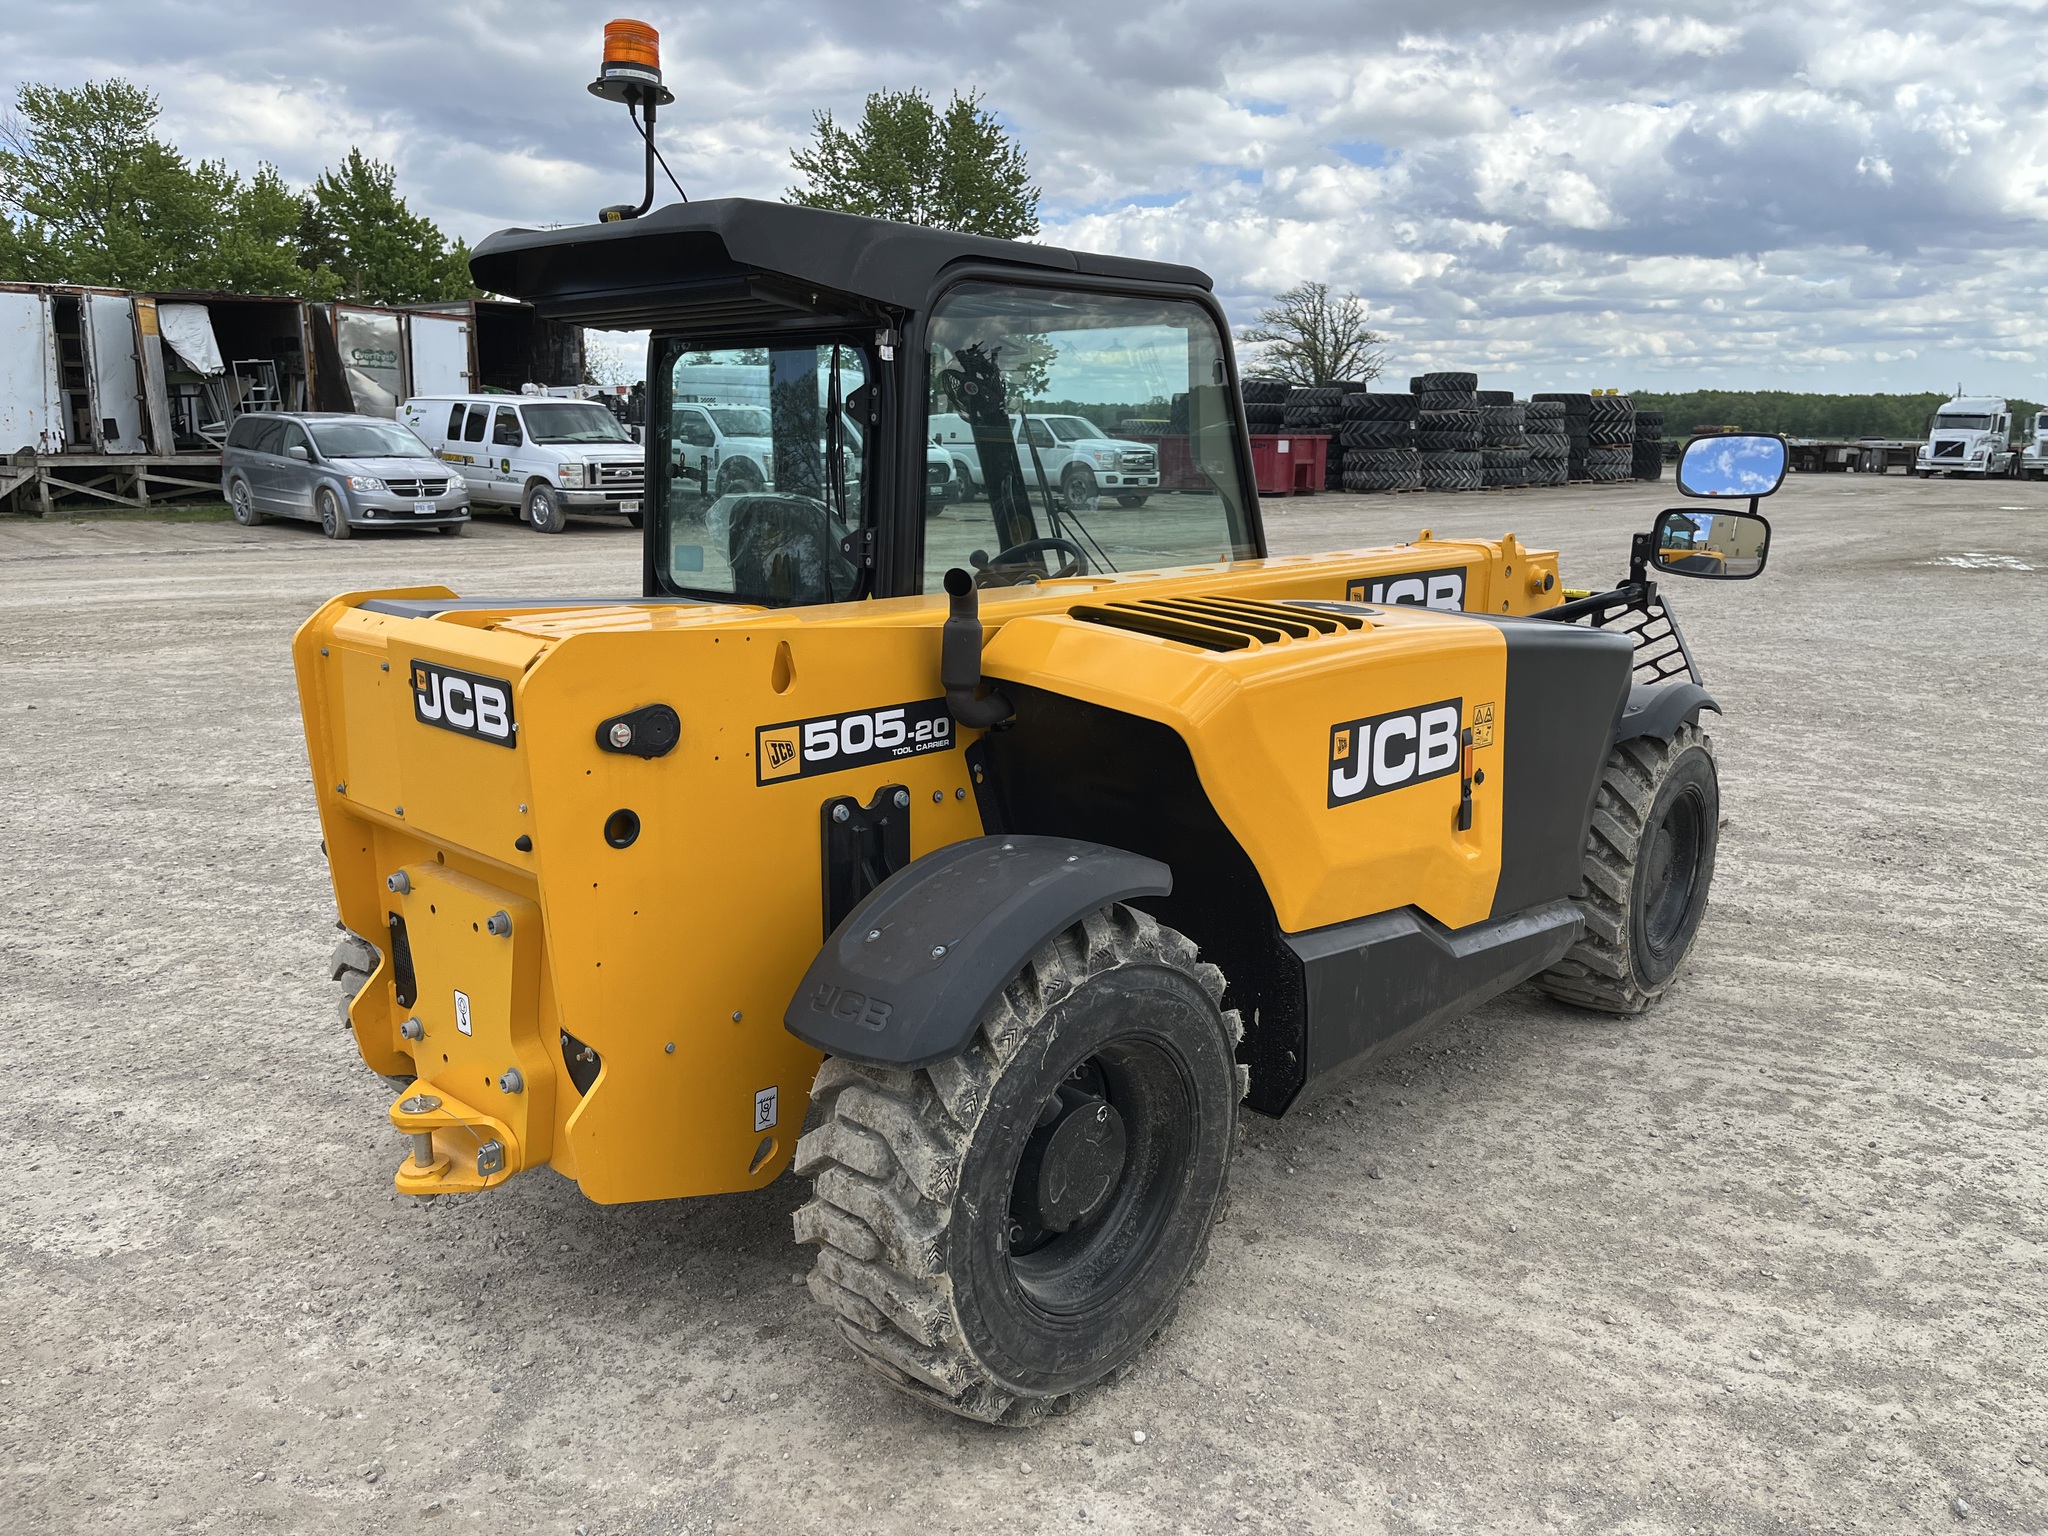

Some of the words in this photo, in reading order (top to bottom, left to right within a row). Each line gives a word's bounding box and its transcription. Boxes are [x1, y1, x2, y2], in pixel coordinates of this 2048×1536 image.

[418, 671, 509, 738] JCB
[771, 742, 794, 765] JCB
[803, 708, 950, 761] 505-20
[892, 747, 913, 756] TOOL
[915, 739, 950, 752] CARRIER
[1332, 706, 1458, 798] JCB
[811, 986, 894, 1032] JCB
